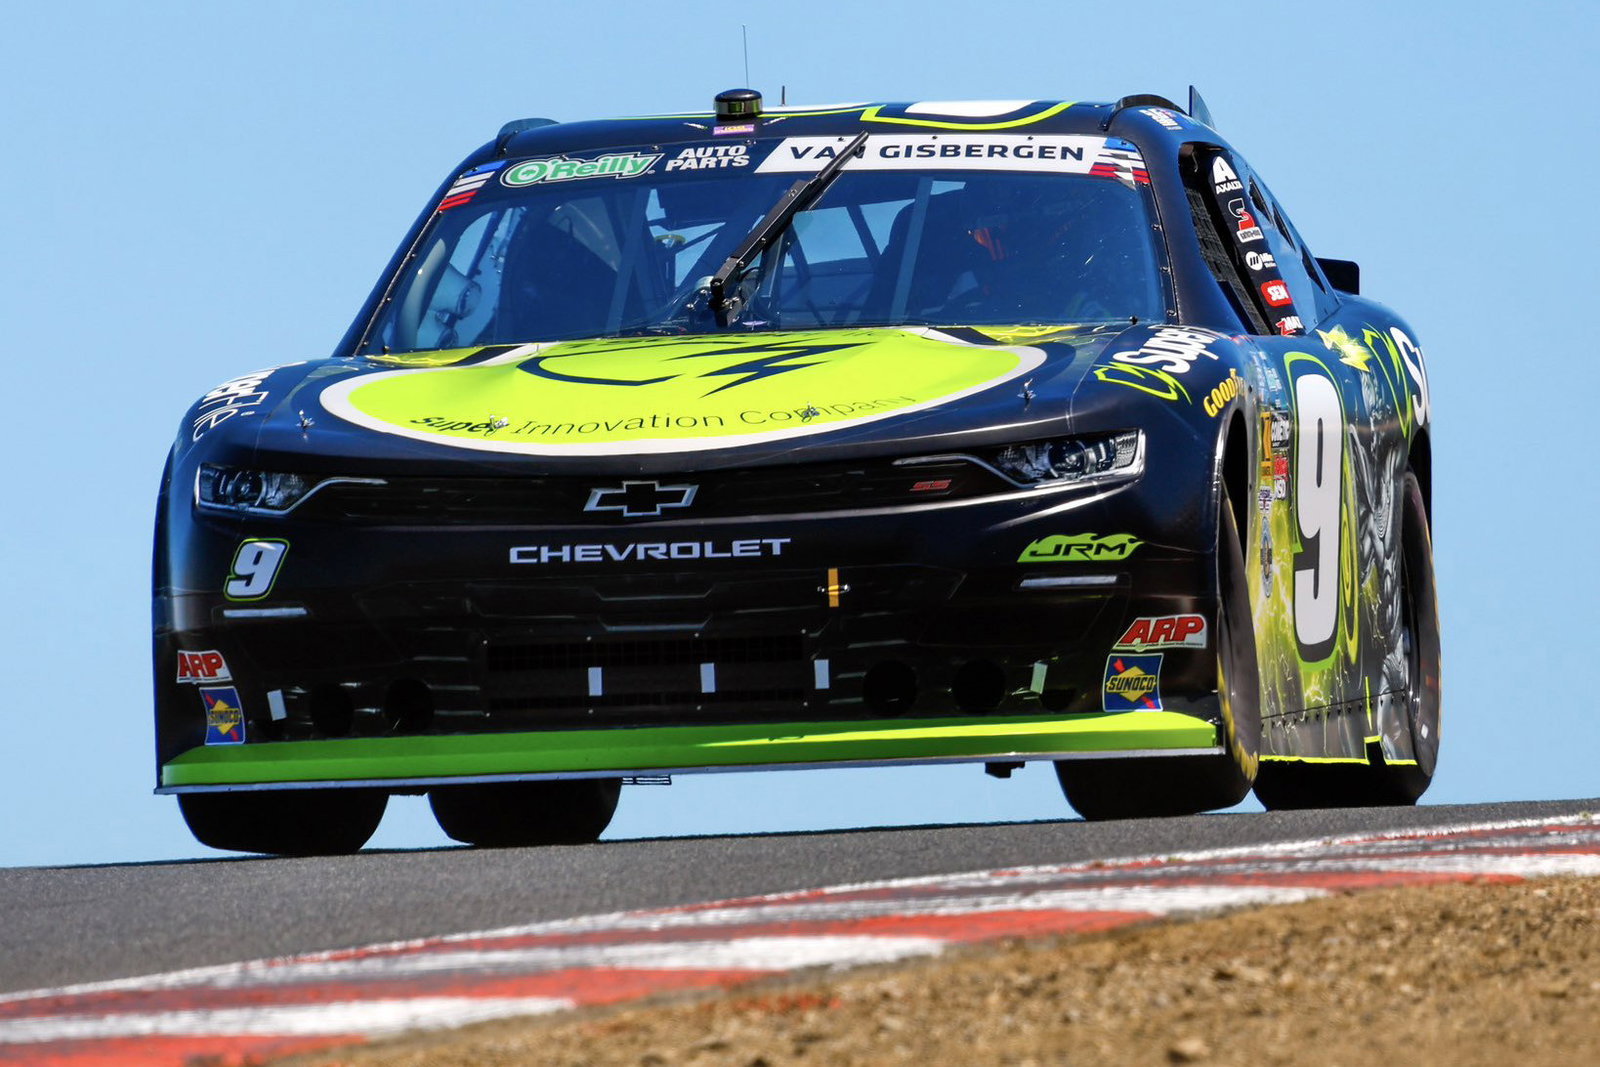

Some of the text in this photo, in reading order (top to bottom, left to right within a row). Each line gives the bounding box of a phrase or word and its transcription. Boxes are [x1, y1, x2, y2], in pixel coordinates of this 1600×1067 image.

[665, 155, 751, 172] PARTS
[677, 145, 747, 159] AUTO
[879, 145, 1083, 161] GISBERGEN
[507, 153, 654, 183] O'Reilly
[510, 411, 724, 435] Innovation
[1295, 374, 1342, 645] 9
[509, 538, 791, 563] CHEVROLET
[1028, 542, 1128, 560] JRM
[225, 540, 288, 598] 9
[1119, 616, 1205, 644] ARP
[178, 652, 224, 677] ARP
[1108, 676, 1156, 692] SUNOCO
[208, 709, 240, 724] SUNOCO
